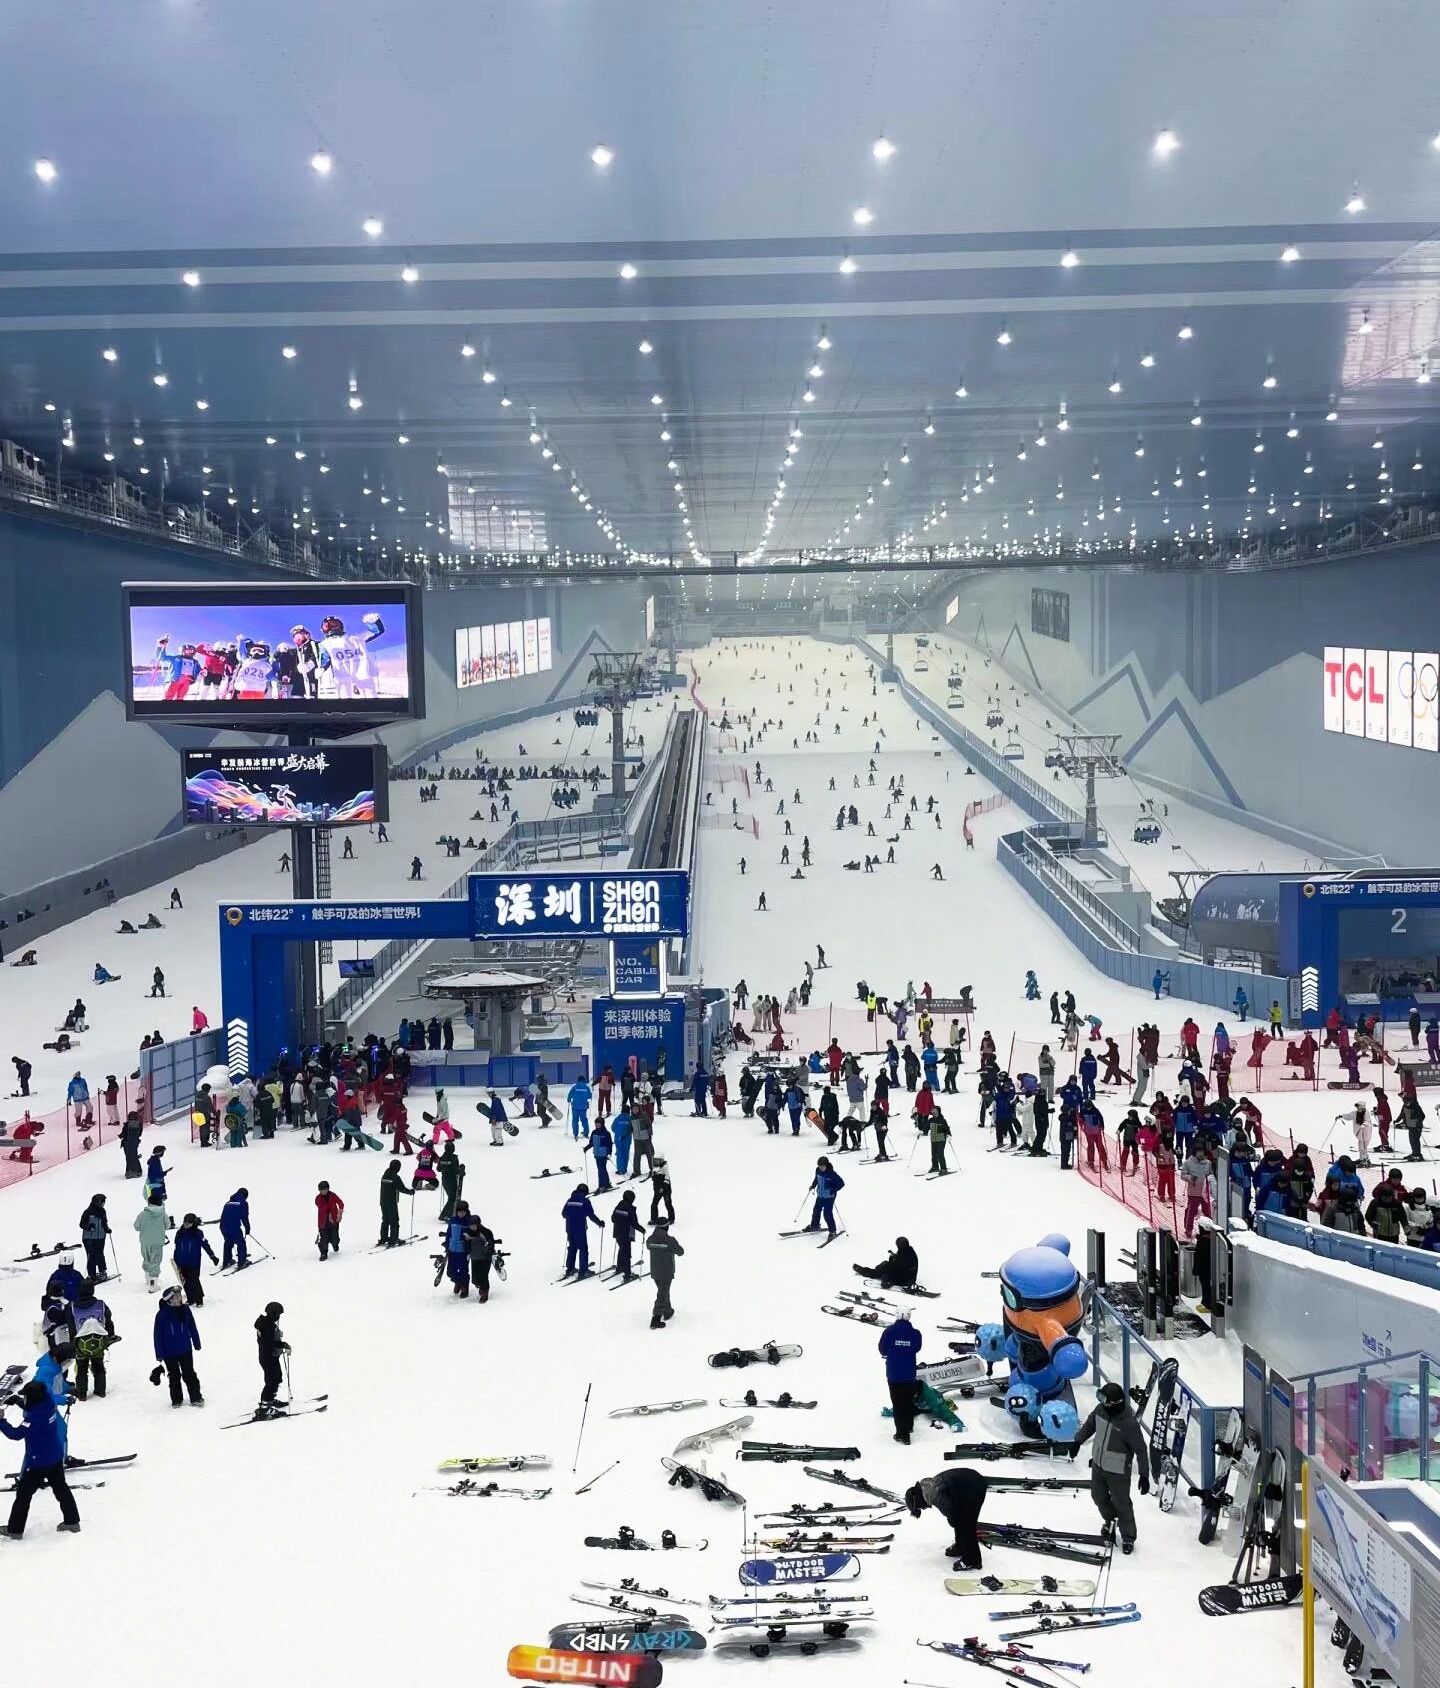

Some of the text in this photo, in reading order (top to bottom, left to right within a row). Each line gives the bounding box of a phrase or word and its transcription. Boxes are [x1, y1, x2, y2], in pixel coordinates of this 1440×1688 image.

[1325, 662, 1384, 704] TCL
[282, 752, 330, 775] 盛大启幕
[495, 881, 581, 926] 深圳
[1391, 908, 1407, 933] 2
[616, 957, 642, 966] NO.
[616, 967, 658, 975] CABLE
[616, 976, 643, 984] CAR
[604, 1008, 672, 1023] 来深圳体验
[774, 1558, 824, 1569] OUTDOOR
[775, 1566, 825, 1580] MASTER
[1239, 1581, 1284, 1595] OUTDOOR
[1241, 1589, 1288, 1607] MASTER
[535, 1654, 631, 1682] NITRO
